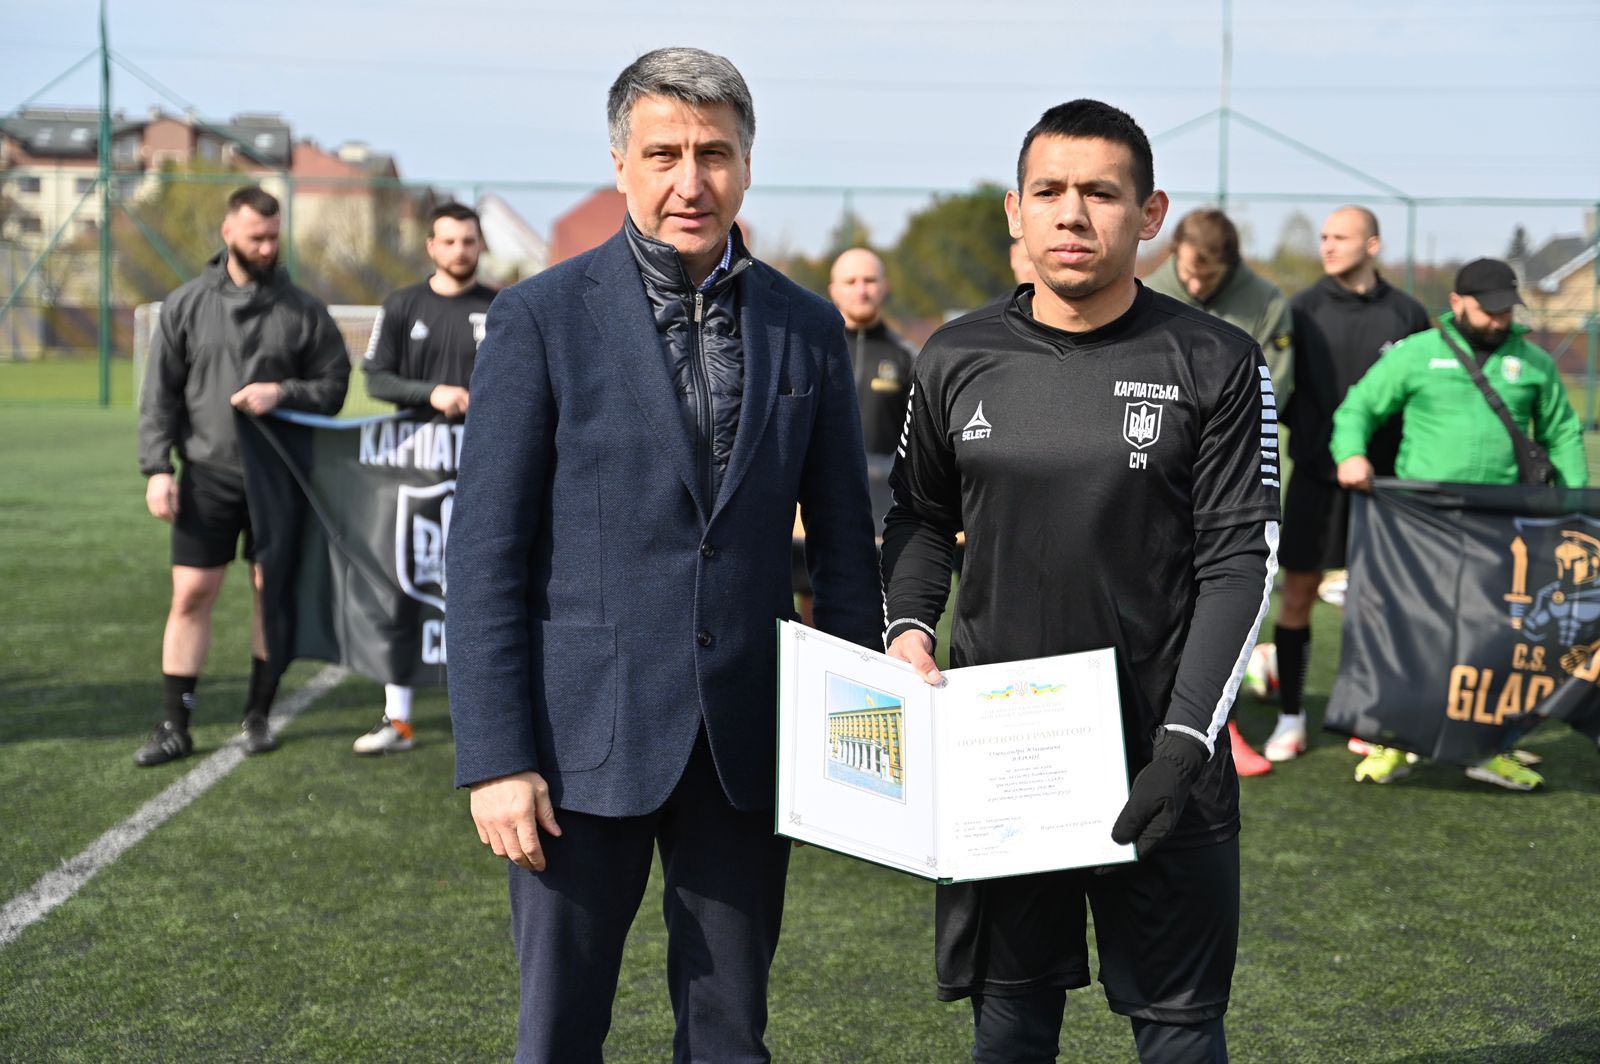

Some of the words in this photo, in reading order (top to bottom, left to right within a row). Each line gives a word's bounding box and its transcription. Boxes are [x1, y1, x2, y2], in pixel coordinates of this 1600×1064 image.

[1114, 381, 1179, 401] КАРПАТСЬКА
[962, 428, 992, 441] SELECT
[1129, 452, 1148, 470] СІЧ
[1512, 643, 1547, 672] C.S.
